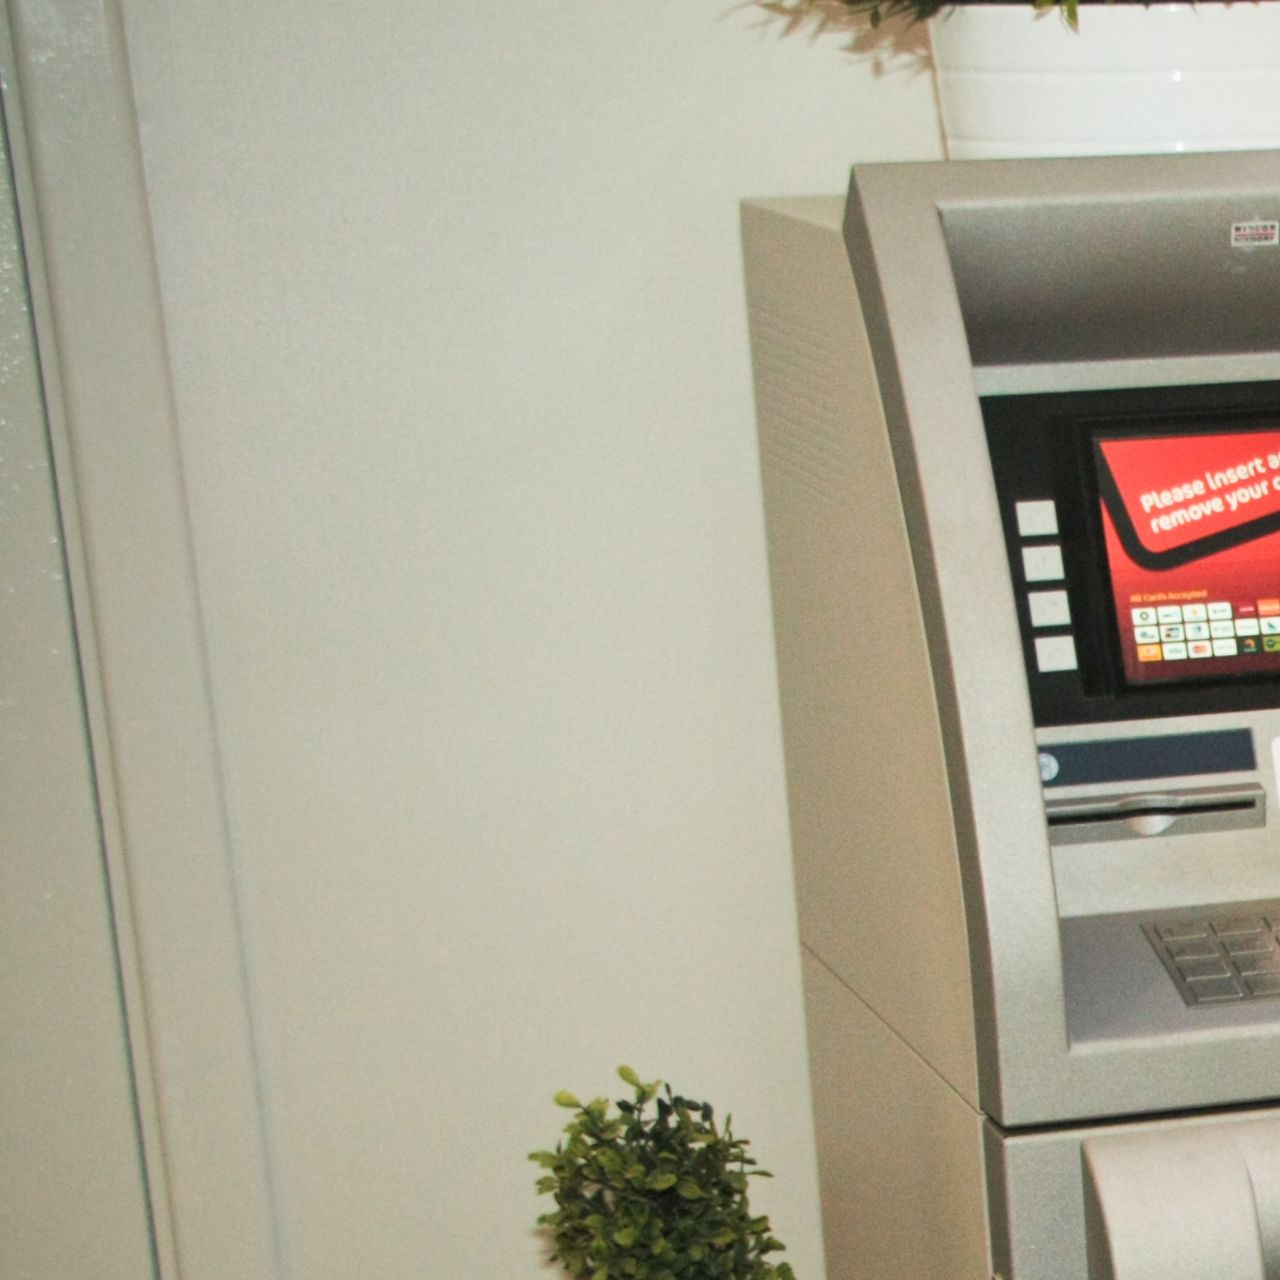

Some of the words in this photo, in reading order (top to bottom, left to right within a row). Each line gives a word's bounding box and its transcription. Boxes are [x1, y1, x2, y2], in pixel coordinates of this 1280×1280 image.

[1139, 479, 1205, 513] Please
[1205, 457, 1266, 491] insert
[1150, 496, 1225, 534] remove
[1224, 480, 1270, 512] your
